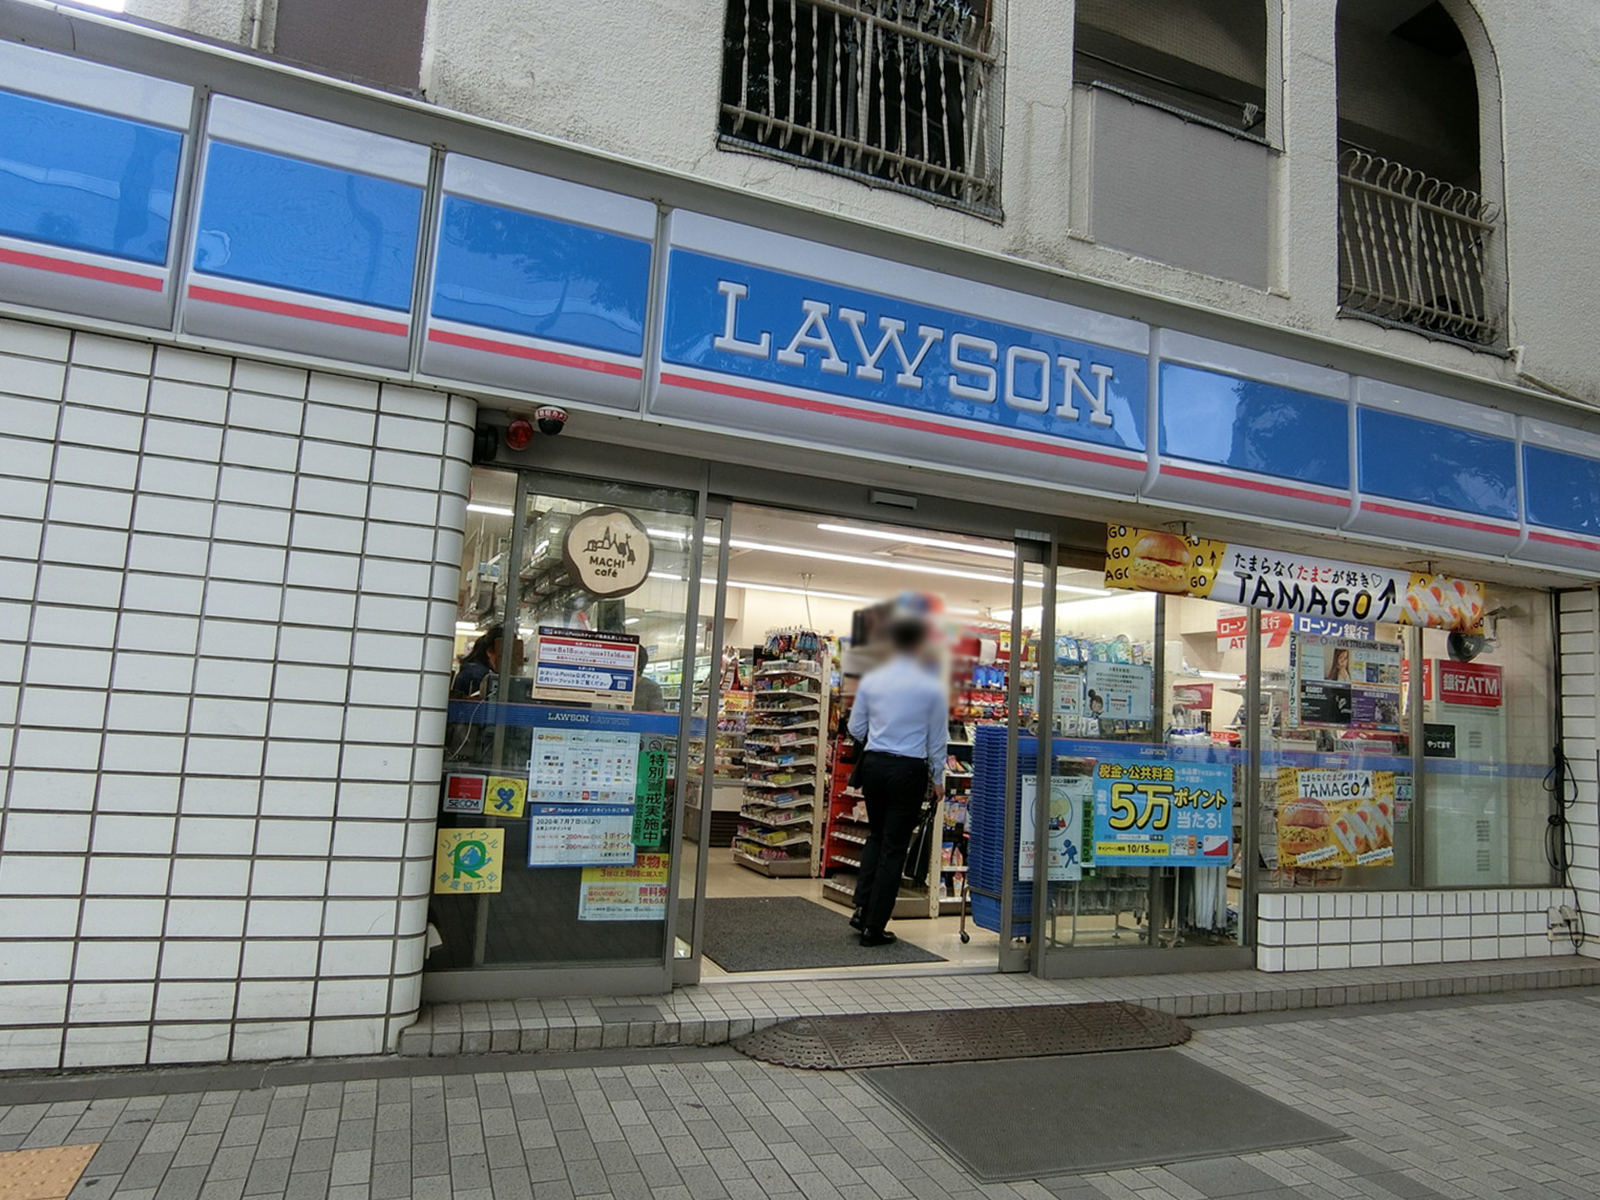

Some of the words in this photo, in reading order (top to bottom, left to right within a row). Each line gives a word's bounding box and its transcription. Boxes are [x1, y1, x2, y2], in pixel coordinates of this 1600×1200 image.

[713, 280, 1114, 427] LAWSON
[589, 555, 625, 569] MACHI
[1235, 552, 1370, 588] たまらなくたまごが好き
[595, 566, 618, 578] café
[1234, 571, 1372, 620] TAMAGO
[1220, 616, 1281, 634] ローソ銀行
[1299, 617, 1370, 640] ローソン銀行
[1229, 638, 1246, 650] AT
[1443, 673, 1499, 695] 銀行ATM
[548, 712, 590, 722] LAWSON
[1099, 763, 1175, 781] 税金・公共料金
[642, 753, 665, 844] 特別警戒実施中
[1302, 781, 1360, 798] TAMAGO
[448, 799, 480, 808] SECOM
[440, 830, 499, 850] リサイクル
[1127, 844, 1150, 853] 10/15
